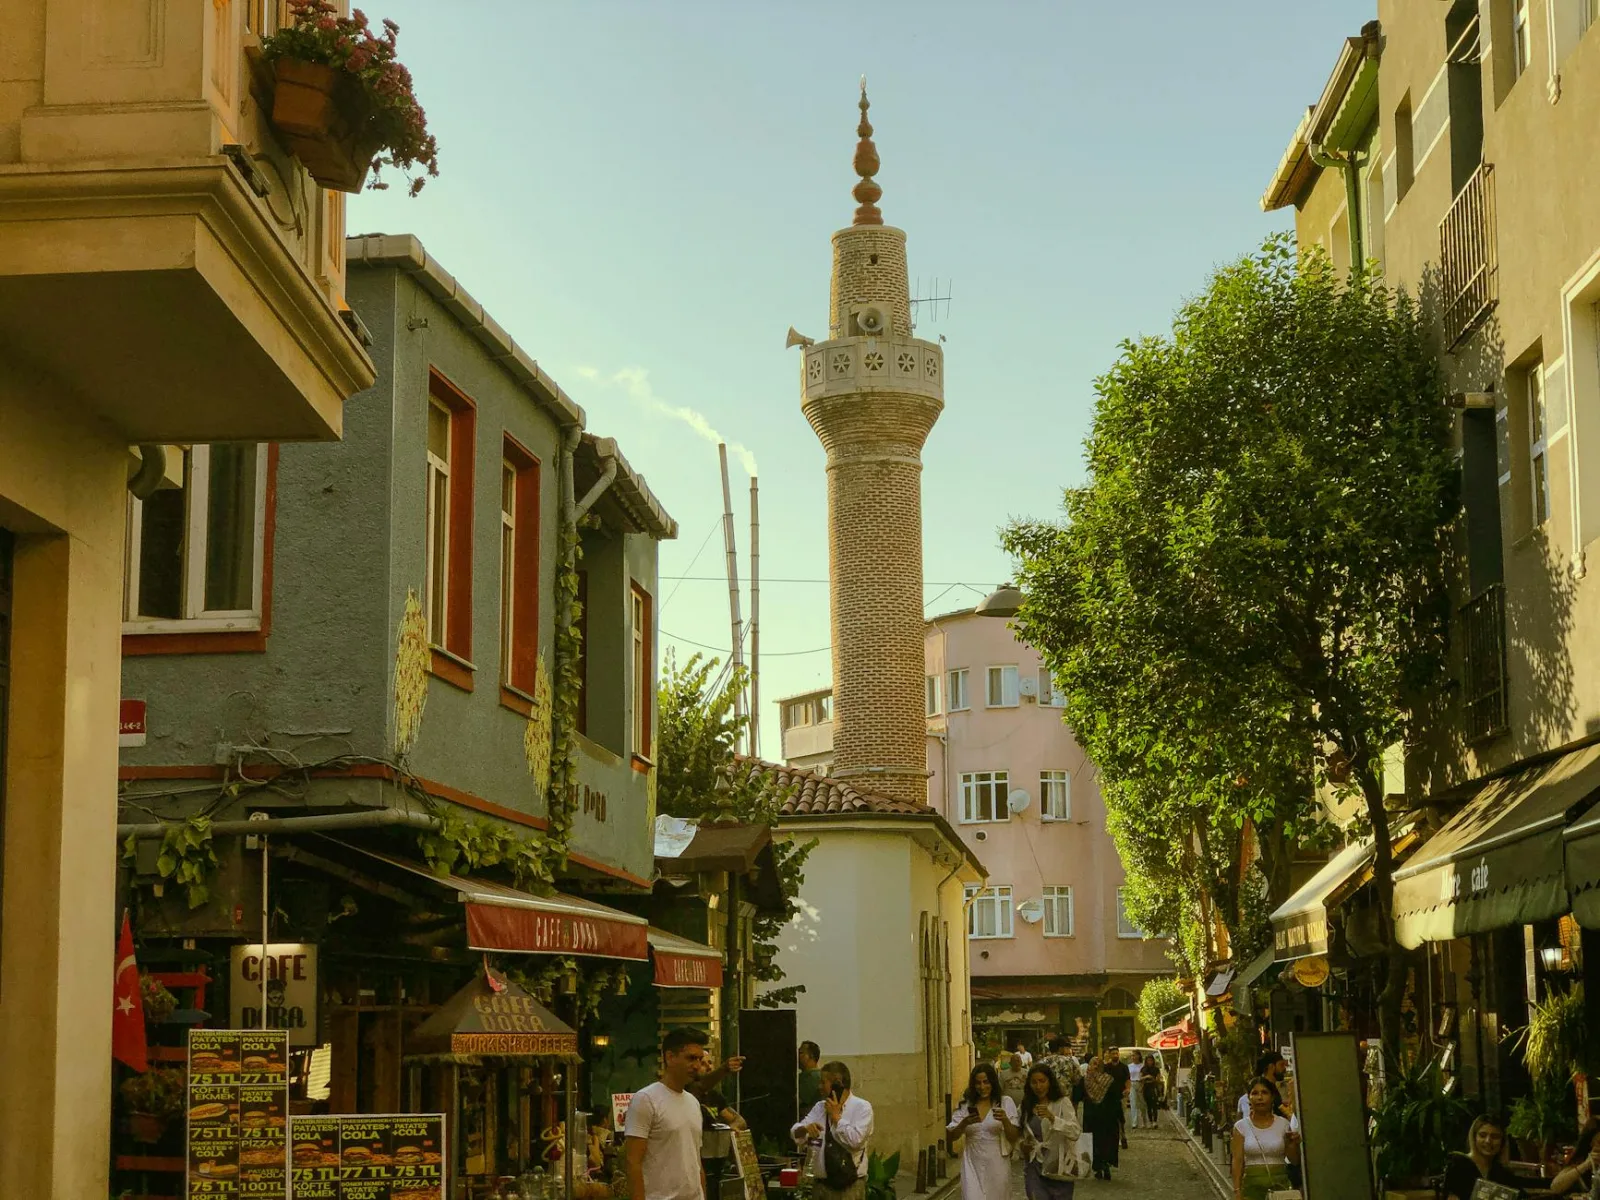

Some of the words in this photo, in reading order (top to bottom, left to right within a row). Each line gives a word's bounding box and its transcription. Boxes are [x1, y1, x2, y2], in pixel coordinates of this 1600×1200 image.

[536, 916, 560, 948] CAFE
[573, 921, 598, 950] DORA
[242, 954, 307, 982] CAFE
[474, 995, 535, 1014] CAFE
[480, 1015, 551, 1032] DORA
[242, 1043, 277, 1051] COLA
[520, 1037, 569, 1053] COFFEE
[191, 1074, 212, 1085] 75
[219, 1074, 240, 1085] TL
[241, 1074, 262, 1084] 77
[265, 1074, 286, 1084] TL
[195, 1093, 235, 1101] EKMEK
[242, 1128, 261, 1138] 75
[265, 1128, 284, 1137] TL
[293, 1132, 321, 1140] COLA
[342, 1131, 380, 1139] COLA
[292, 1169, 313, 1181] 75
[318, 1168, 340, 1180] TL
[341, 1167, 363, 1178] 77
[368, 1167, 391, 1177] TL
[395, 1166, 416, 1177] 75
[419, 1165, 440, 1176] TL
[191, 1181, 212, 1192] 75
[217, 1181, 238, 1191] TL
[297, 1190, 336, 1198] EKMEK
[347, 1192, 376, 1200] COLA
